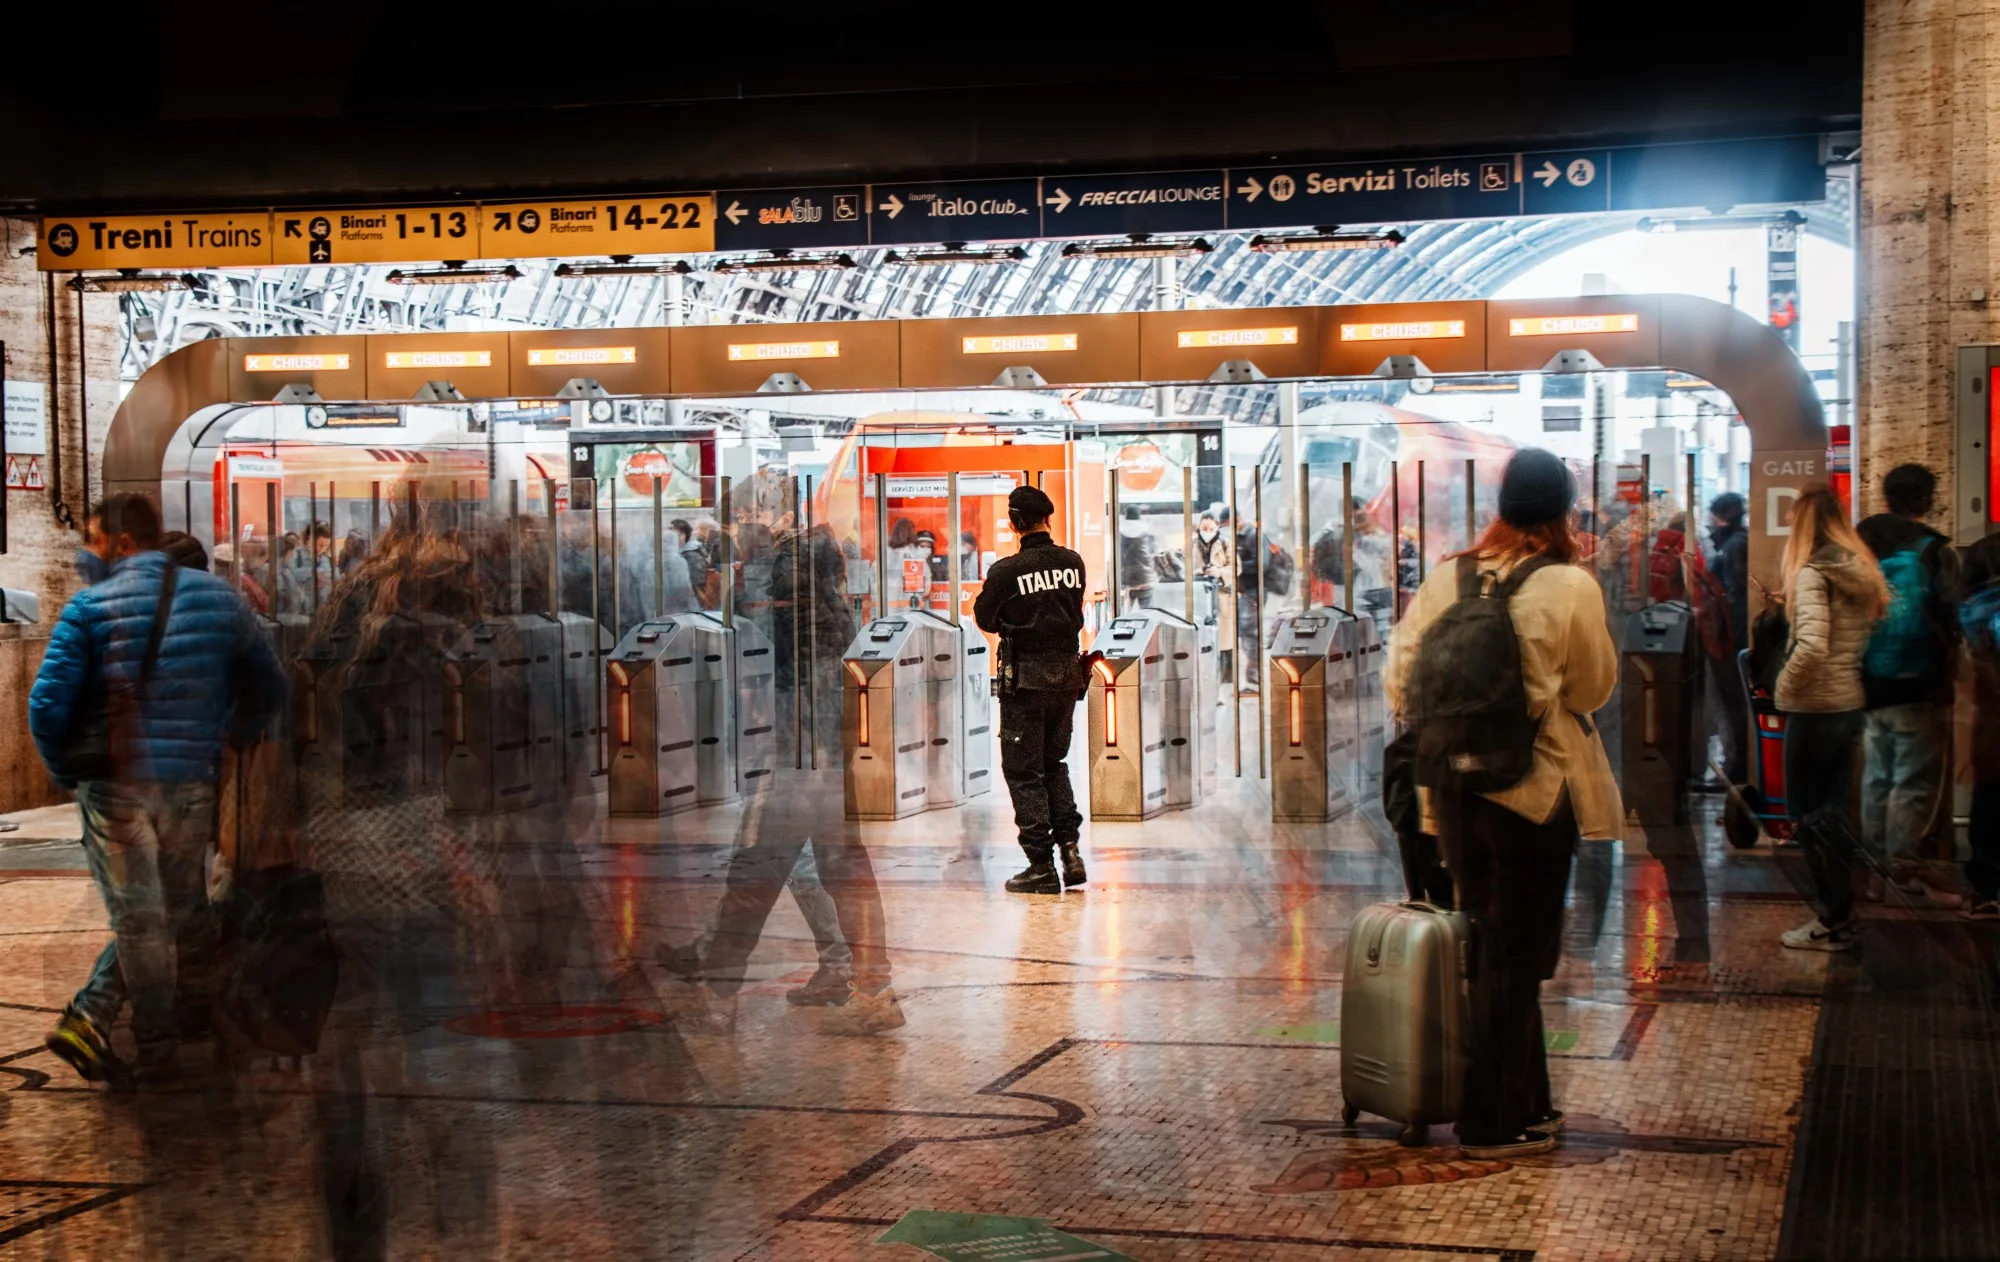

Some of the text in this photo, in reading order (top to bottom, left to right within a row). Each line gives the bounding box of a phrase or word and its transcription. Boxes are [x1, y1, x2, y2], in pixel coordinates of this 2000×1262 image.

[1306, 165, 1470, 195] Servizi Toilets
[908, 193, 937, 201] lounge
[1079, 186, 1221, 206] FRECCIALOUNGE
[550, 207, 597, 221] Binari
[979, 199, 1016, 215] Club
[340, 214, 387, 229] Binari
[605, 202, 701, 231] 14-22
[395, 211, 467, 239] 1-13
[550, 222, 594, 234] Platforms
[90, 220, 261, 250] Treni Trains
[340, 230, 383, 241] Platforms
[1372, 325, 1432, 337] CHIUSO
[1541, 319, 1604, 333] CHIUSO
[992, 338, 1048, 351] CHIUSO
[1208, 331, 1265, 345] CHIUSO
[555, 350, 609, 362] CHIUSO
[756, 344, 810, 357] CHIUSO
[272, 356, 323, 369] CHIUSO
[412, 354, 466, 365] CHIUSO
[1202, 435, 1220, 451] 14
[573, 446, 589, 462] 13
[1762, 460, 1815, 476] GATE
[891, 485, 915, 493] SERVIZI
[1766, 486, 1803, 537] D
[1017, 568, 1081, 596] ITALPOL
